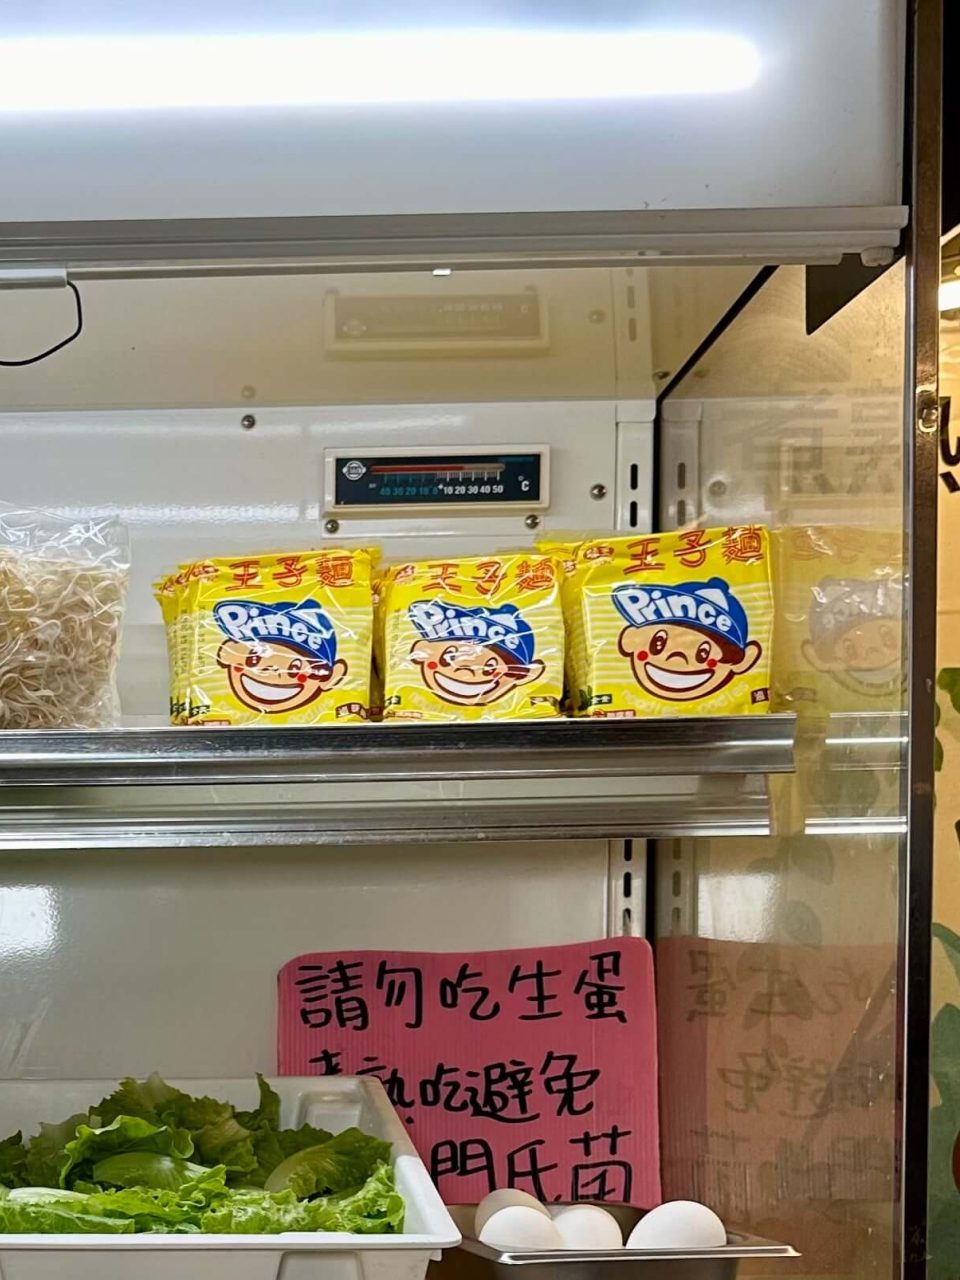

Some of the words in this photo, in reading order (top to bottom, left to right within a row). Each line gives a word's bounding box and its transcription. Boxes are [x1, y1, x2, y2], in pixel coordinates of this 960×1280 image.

[455, 486, 466, 495] 20
[467, 485, 478, 494] 30
[479, 485, 490, 494] 40
[492, 485, 503, 494] 50
[225, 553, 355, 592] 王子麵
[623, 525, 764, 574] 王子麵
[422, 558, 555, 595] 王子麵
[217, 604, 322, 650] Prince
[410, 602, 520, 649] Prince
[621, 587, 732, 632] Prince
[294, 949, 628, 1031] 請勿吃生蛋
[430, 1125, 633, 1204] 門氏菌
